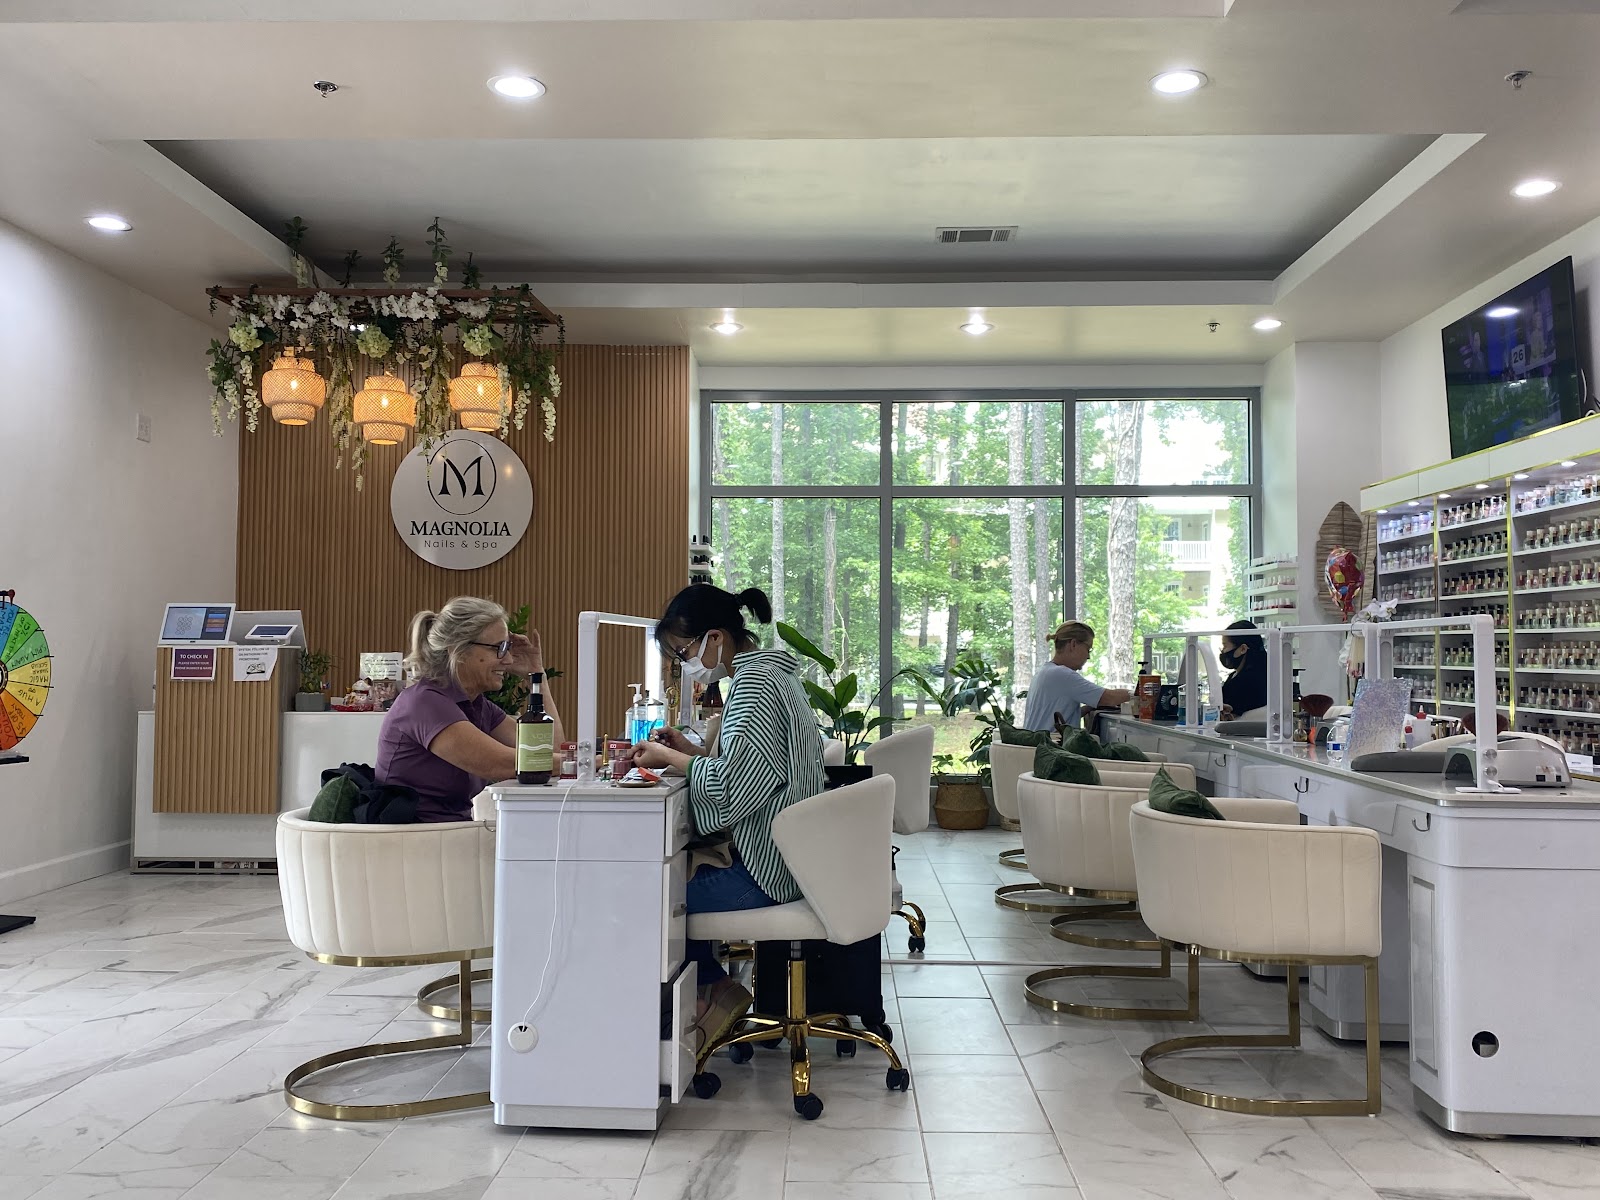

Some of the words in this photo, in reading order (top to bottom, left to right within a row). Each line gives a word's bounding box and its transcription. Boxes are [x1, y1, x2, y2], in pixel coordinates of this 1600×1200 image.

[1513, 349, 1524, 364] 26
[438, 455, 485, 498] M
[410, 520, 512, 537] MAGNOLIA
[424, 540, 455, 548] Nails
[460, 540, 468, 549] &
[474, 540, 498, 551] Spa
[18, 689, 34, 702] HUG
